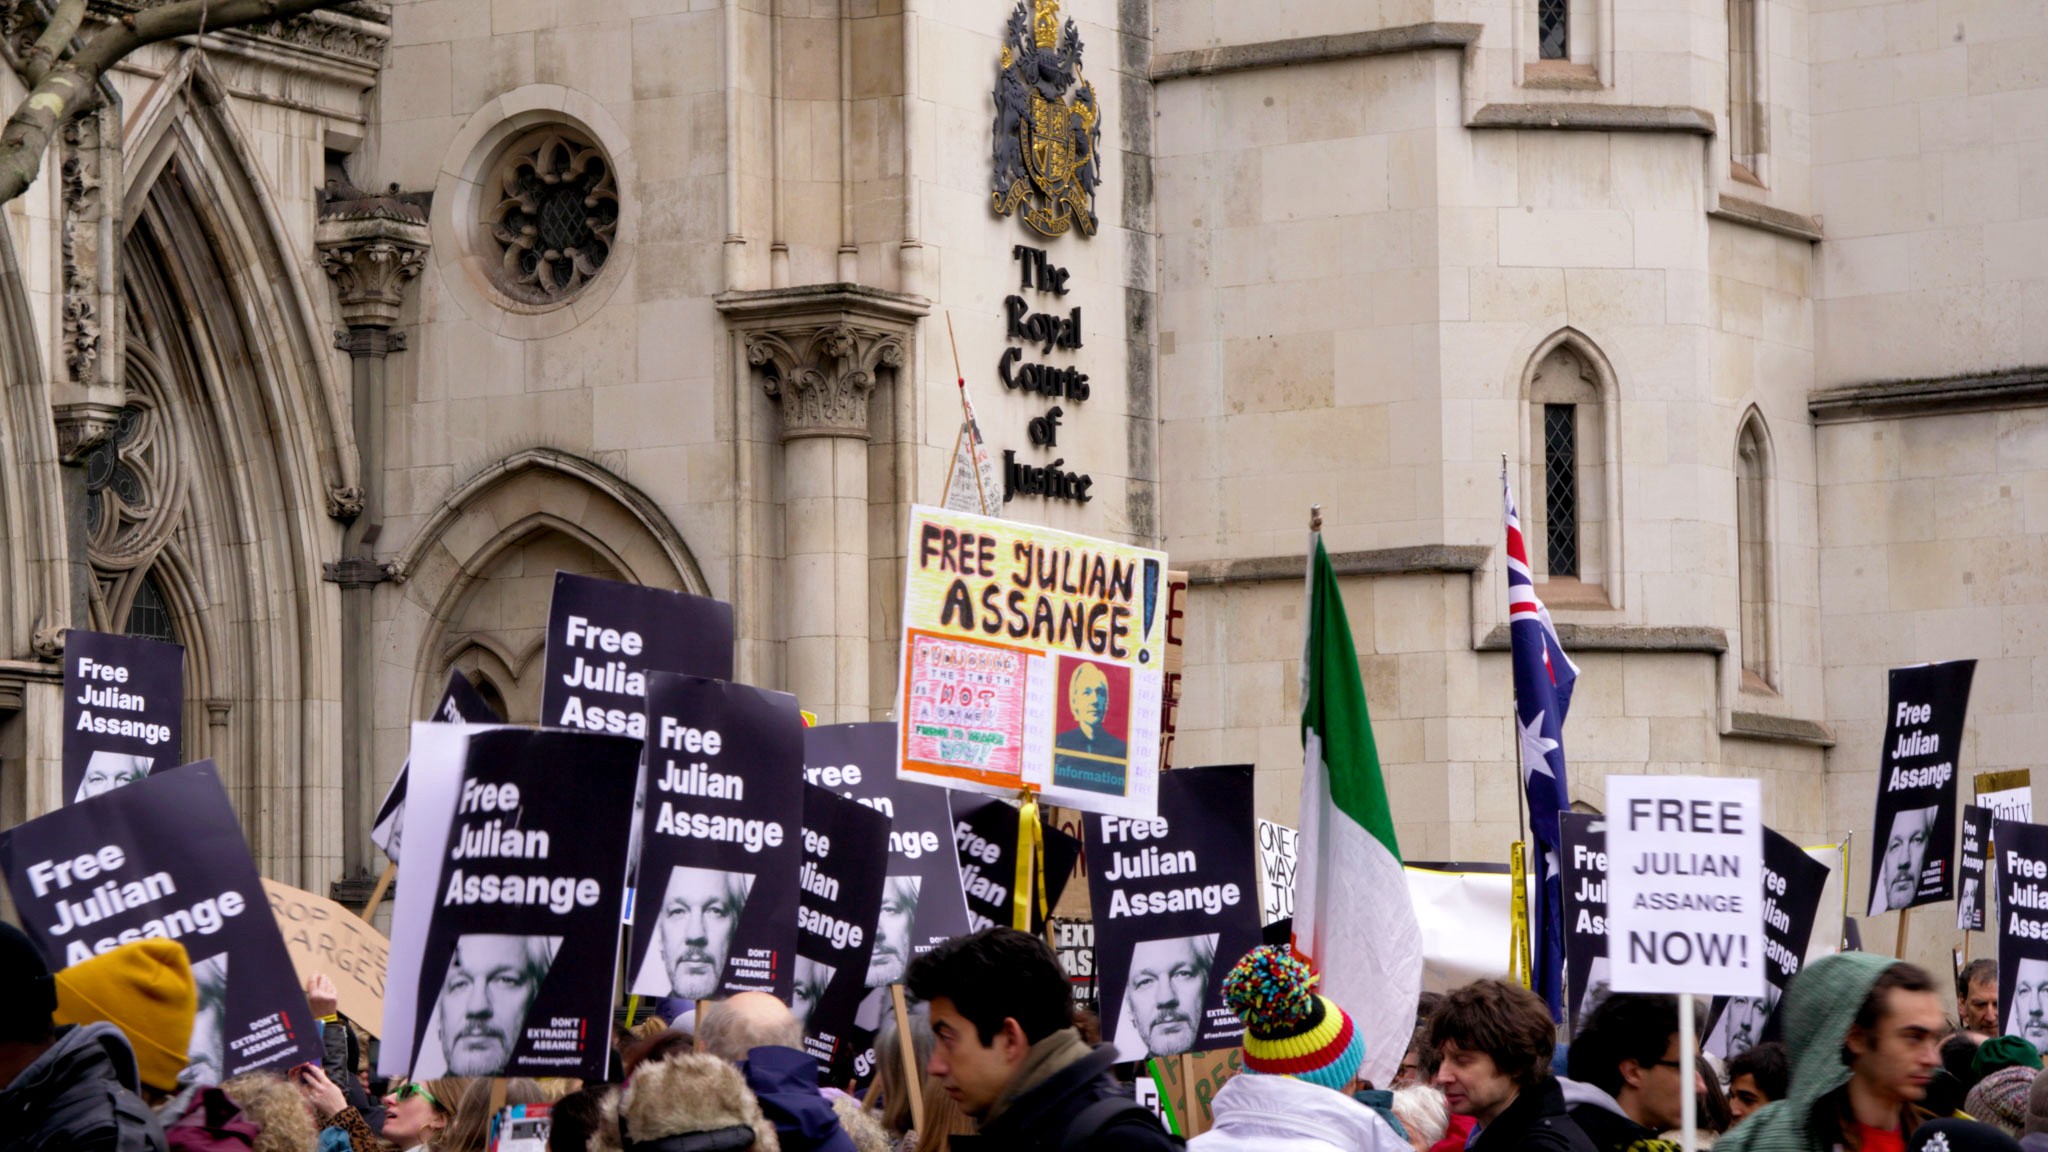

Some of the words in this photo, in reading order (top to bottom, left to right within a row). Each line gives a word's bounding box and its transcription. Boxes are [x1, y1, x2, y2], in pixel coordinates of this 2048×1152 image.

[1013, 245, 1070, 295] The
[1005, 295, 1083, 354] Royal
[999, 347, 1090, 401] Courts
[1029, 406, 1063, 447] of
[1003, 449, 1093, 502] Justice
[920, 523, 997, 577] FREE
[1012, 540, 1137, 602] JULIAN
[566, 615, 643, 656] Free
[940, 578, 1132, 660] ASSANGE
[78, 657, 129, 683] Free
[563, 657, 646, 697] Julia
[931, 669, 955, 680] THE
[968, 673, 1011, 685] TRUTH
[77, 684, 145, 712] Julian
[915, 686, 926, 695] IS
[940, 683, 995, 708] NOT
[76, 711, 170, 745] Assange
[560, 696, 647, 738] Assa
[1896, 701, 1931, 728] Free
[659, 716, 722, 755] Free
[1892, 729, 1939, 759] Julian
[658, 759, 744, 801] Julian
[803, 764, 862, 787] ree
[1887, 762, 1952, 793] Assange
[458, 777, 520, 815] Free
[655, 802, 784, 853] Assange
[1101, 815, 1168, 844] Free
[1629, 798, 1744, 835] FREE
[1964, 820, 1976, 836] Free
[452, 819, 550, 860] Julian
[955, 821, 1001, 864] Free
[1259, 822, 1291, 858] ONE
[26, 844, 126, 898] Free
[1105, 845, 1197, 881] Julian
[1261, 851, 1297, 887] WAY
[1574, 845, 1609, 872] Fre
[1633, 852, 1740, 878] JULIAN
[1962, 853, 1984, 873] Assange
[2007, 851, 2047, 879] Free
[443, 869, 601, 914] Assange
[800, 861, 840, 901] lian
[960, 864, 1007, 907] lian
[1575, 877, 1608, 904] Jul
[1761, 860, 1787, 896] ree
[2008, 882, 2048, 910] Julia
[48, 871, 177, 936] Julian
[1109, 883, 1241, 919] Assange
[1632, 892, 1743, 914] ASSANGE
[1762, 897, 1790, 934] lian
[798, 905, 863, 950] sange
[287, 929, 386, 999] ARGES
[731, 957, 770, 969] EXTRADITE
[1628, 930, 1749, 968] NOW!
[735, 968, 770, 980] ASSANGE
[230, 1023, 284, 1050] EXTRADITE
[527, 1028, 578, 1039] EXTRADITE
[551, 1017, 580, 1028] DON'T
[533, 1040, 577, 1050] ASSANGE
